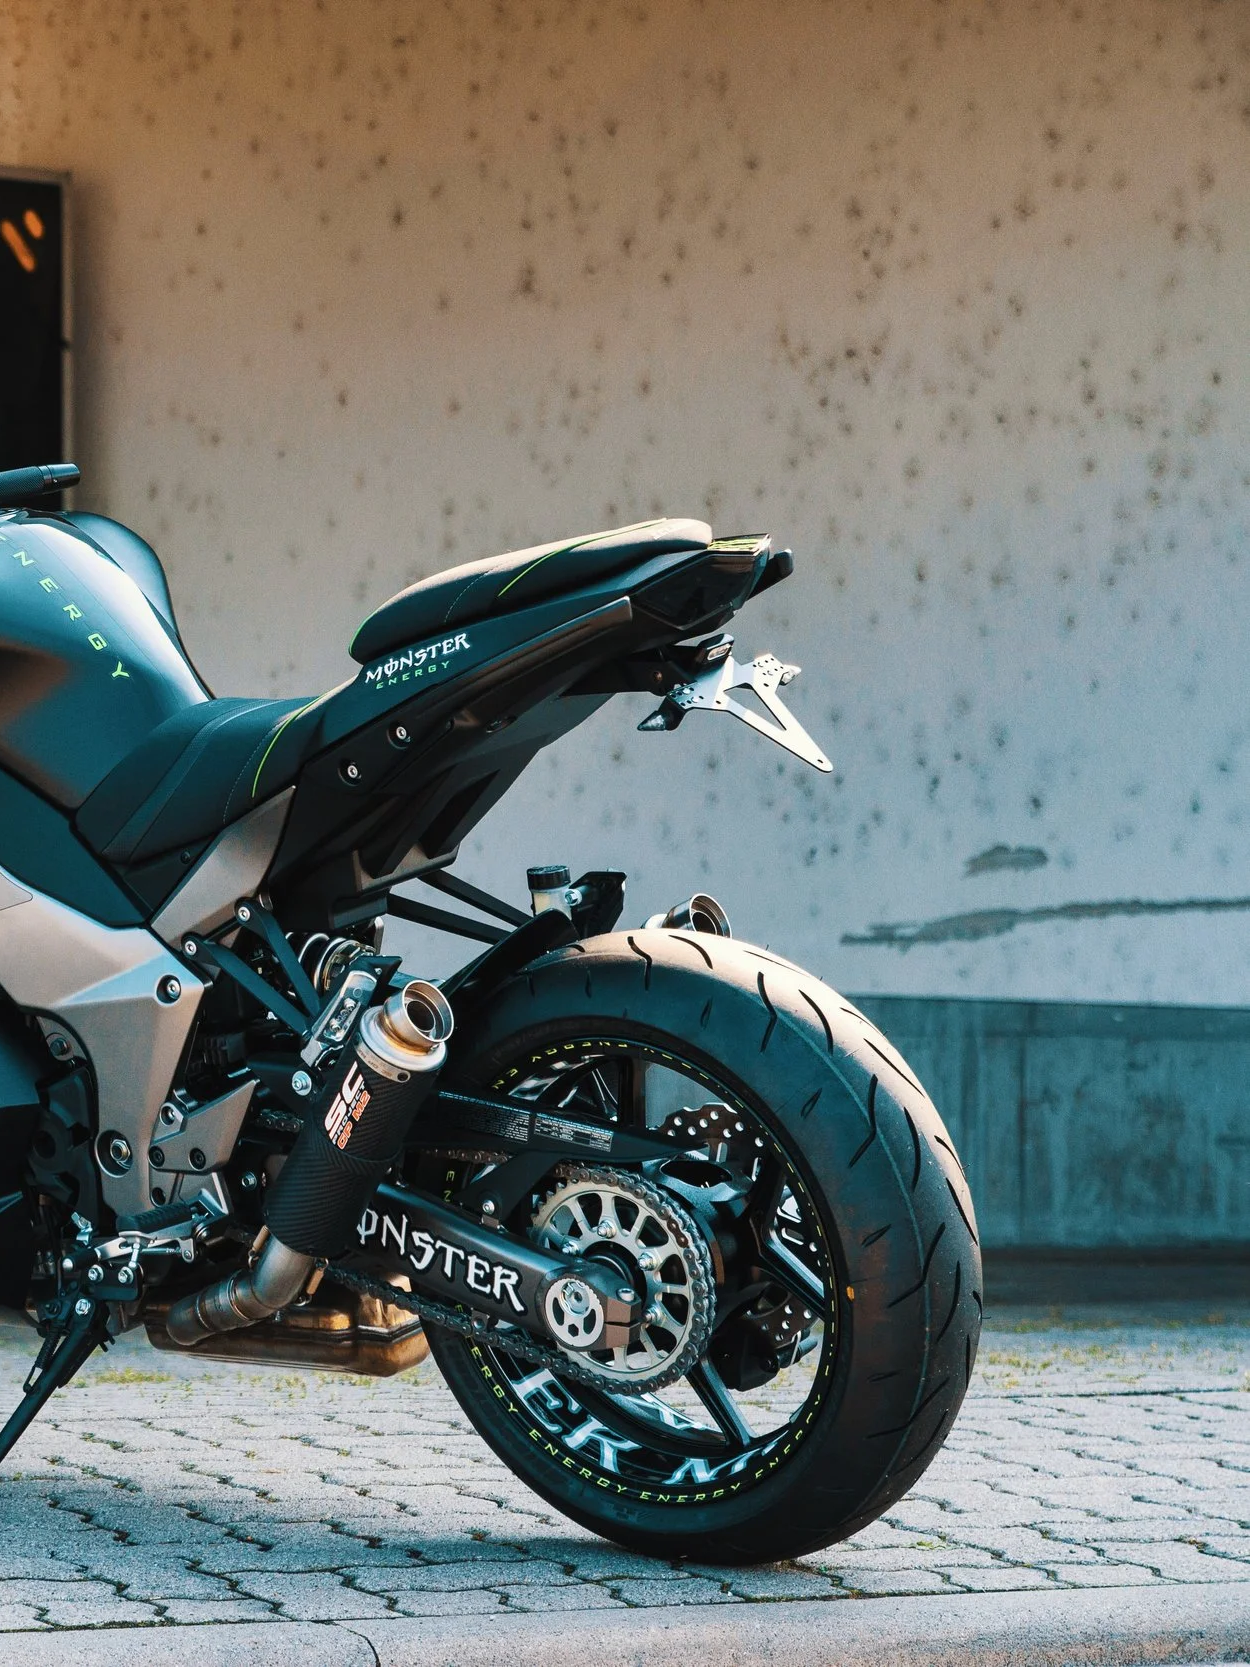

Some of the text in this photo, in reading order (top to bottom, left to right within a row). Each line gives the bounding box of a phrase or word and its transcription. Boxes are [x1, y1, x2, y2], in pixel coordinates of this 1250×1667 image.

[376, 660, 450, 690] ENERGY
[529, 1428, 628, 1494] ENERGY
[639, 1482, 741, 1503] ENERGY
